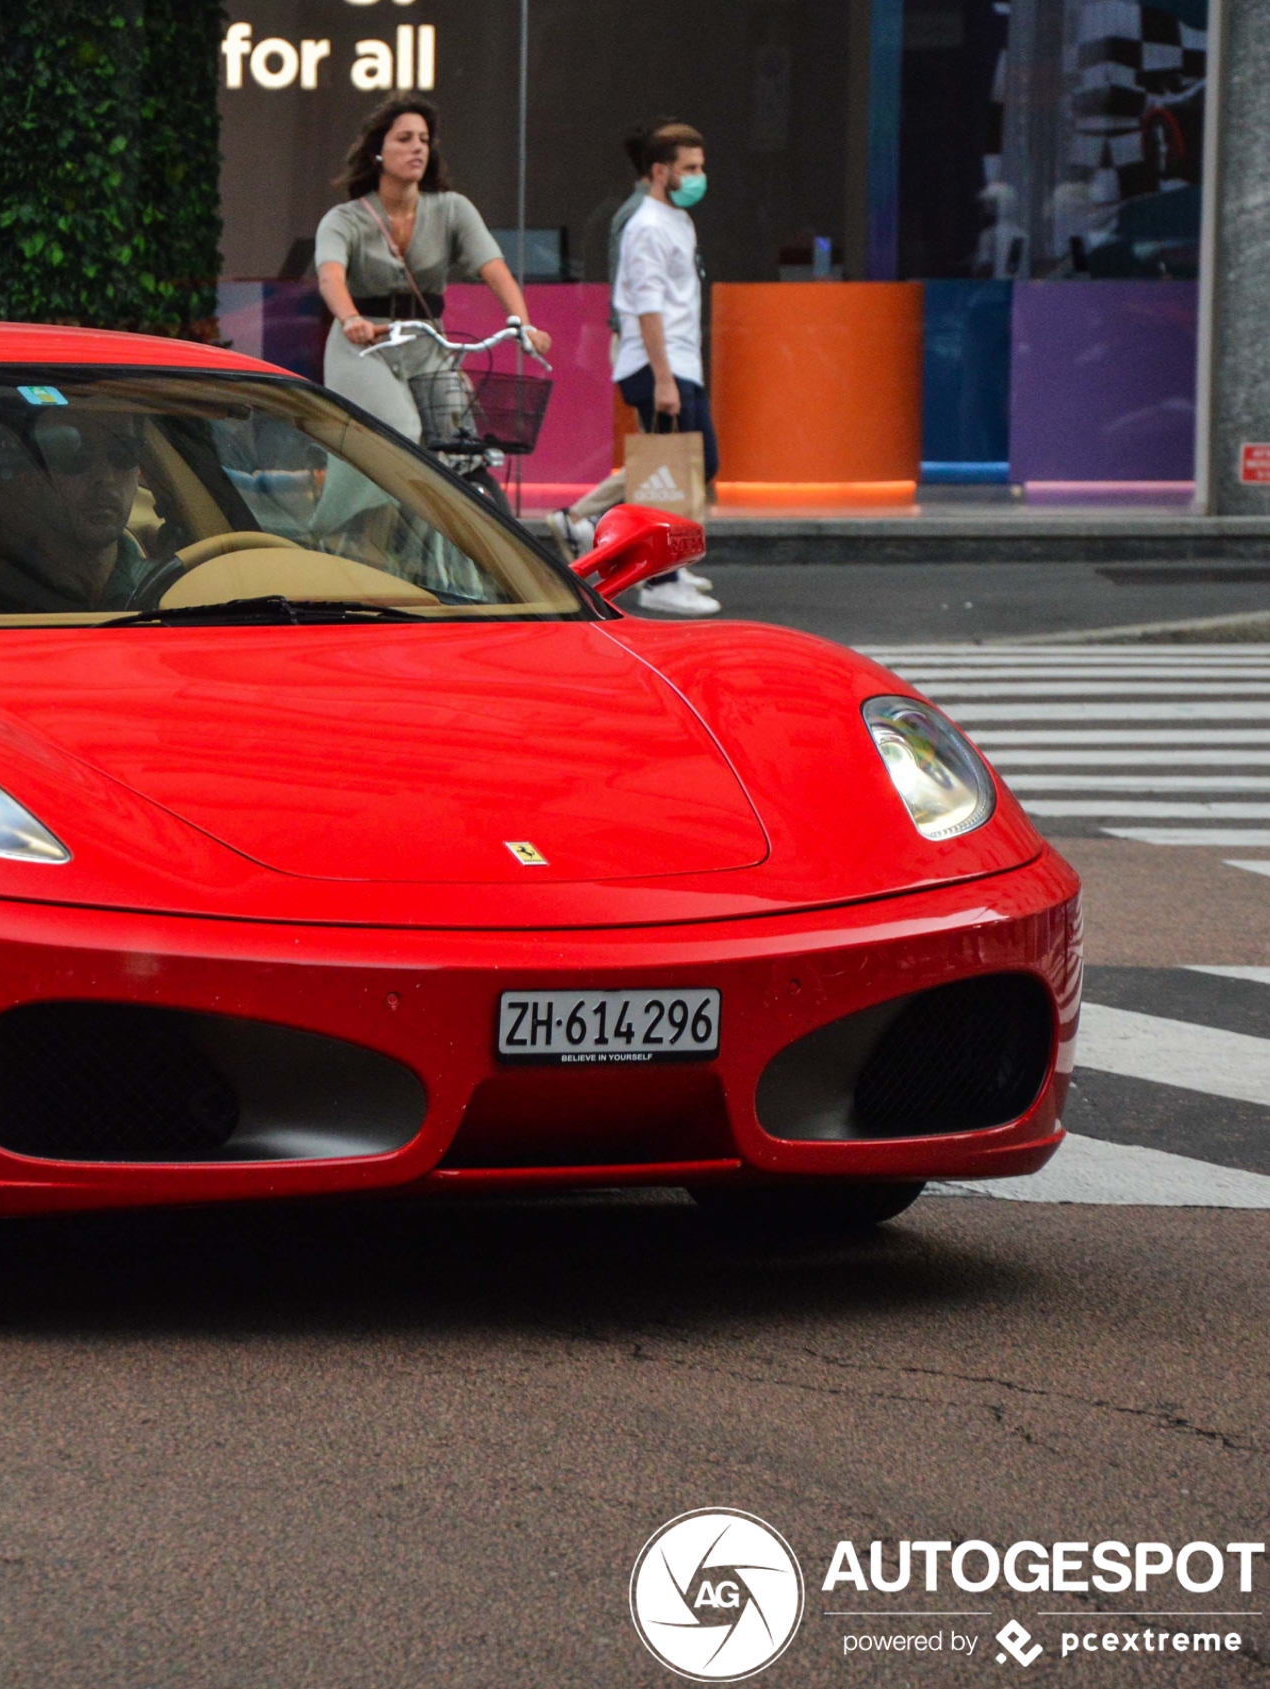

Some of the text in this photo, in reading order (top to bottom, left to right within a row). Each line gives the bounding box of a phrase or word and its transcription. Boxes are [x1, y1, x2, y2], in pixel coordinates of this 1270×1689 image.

[221, 22, 435, 90] for all
[561, 1053, 653, 1062] BELIEVE IN YOURSELF
